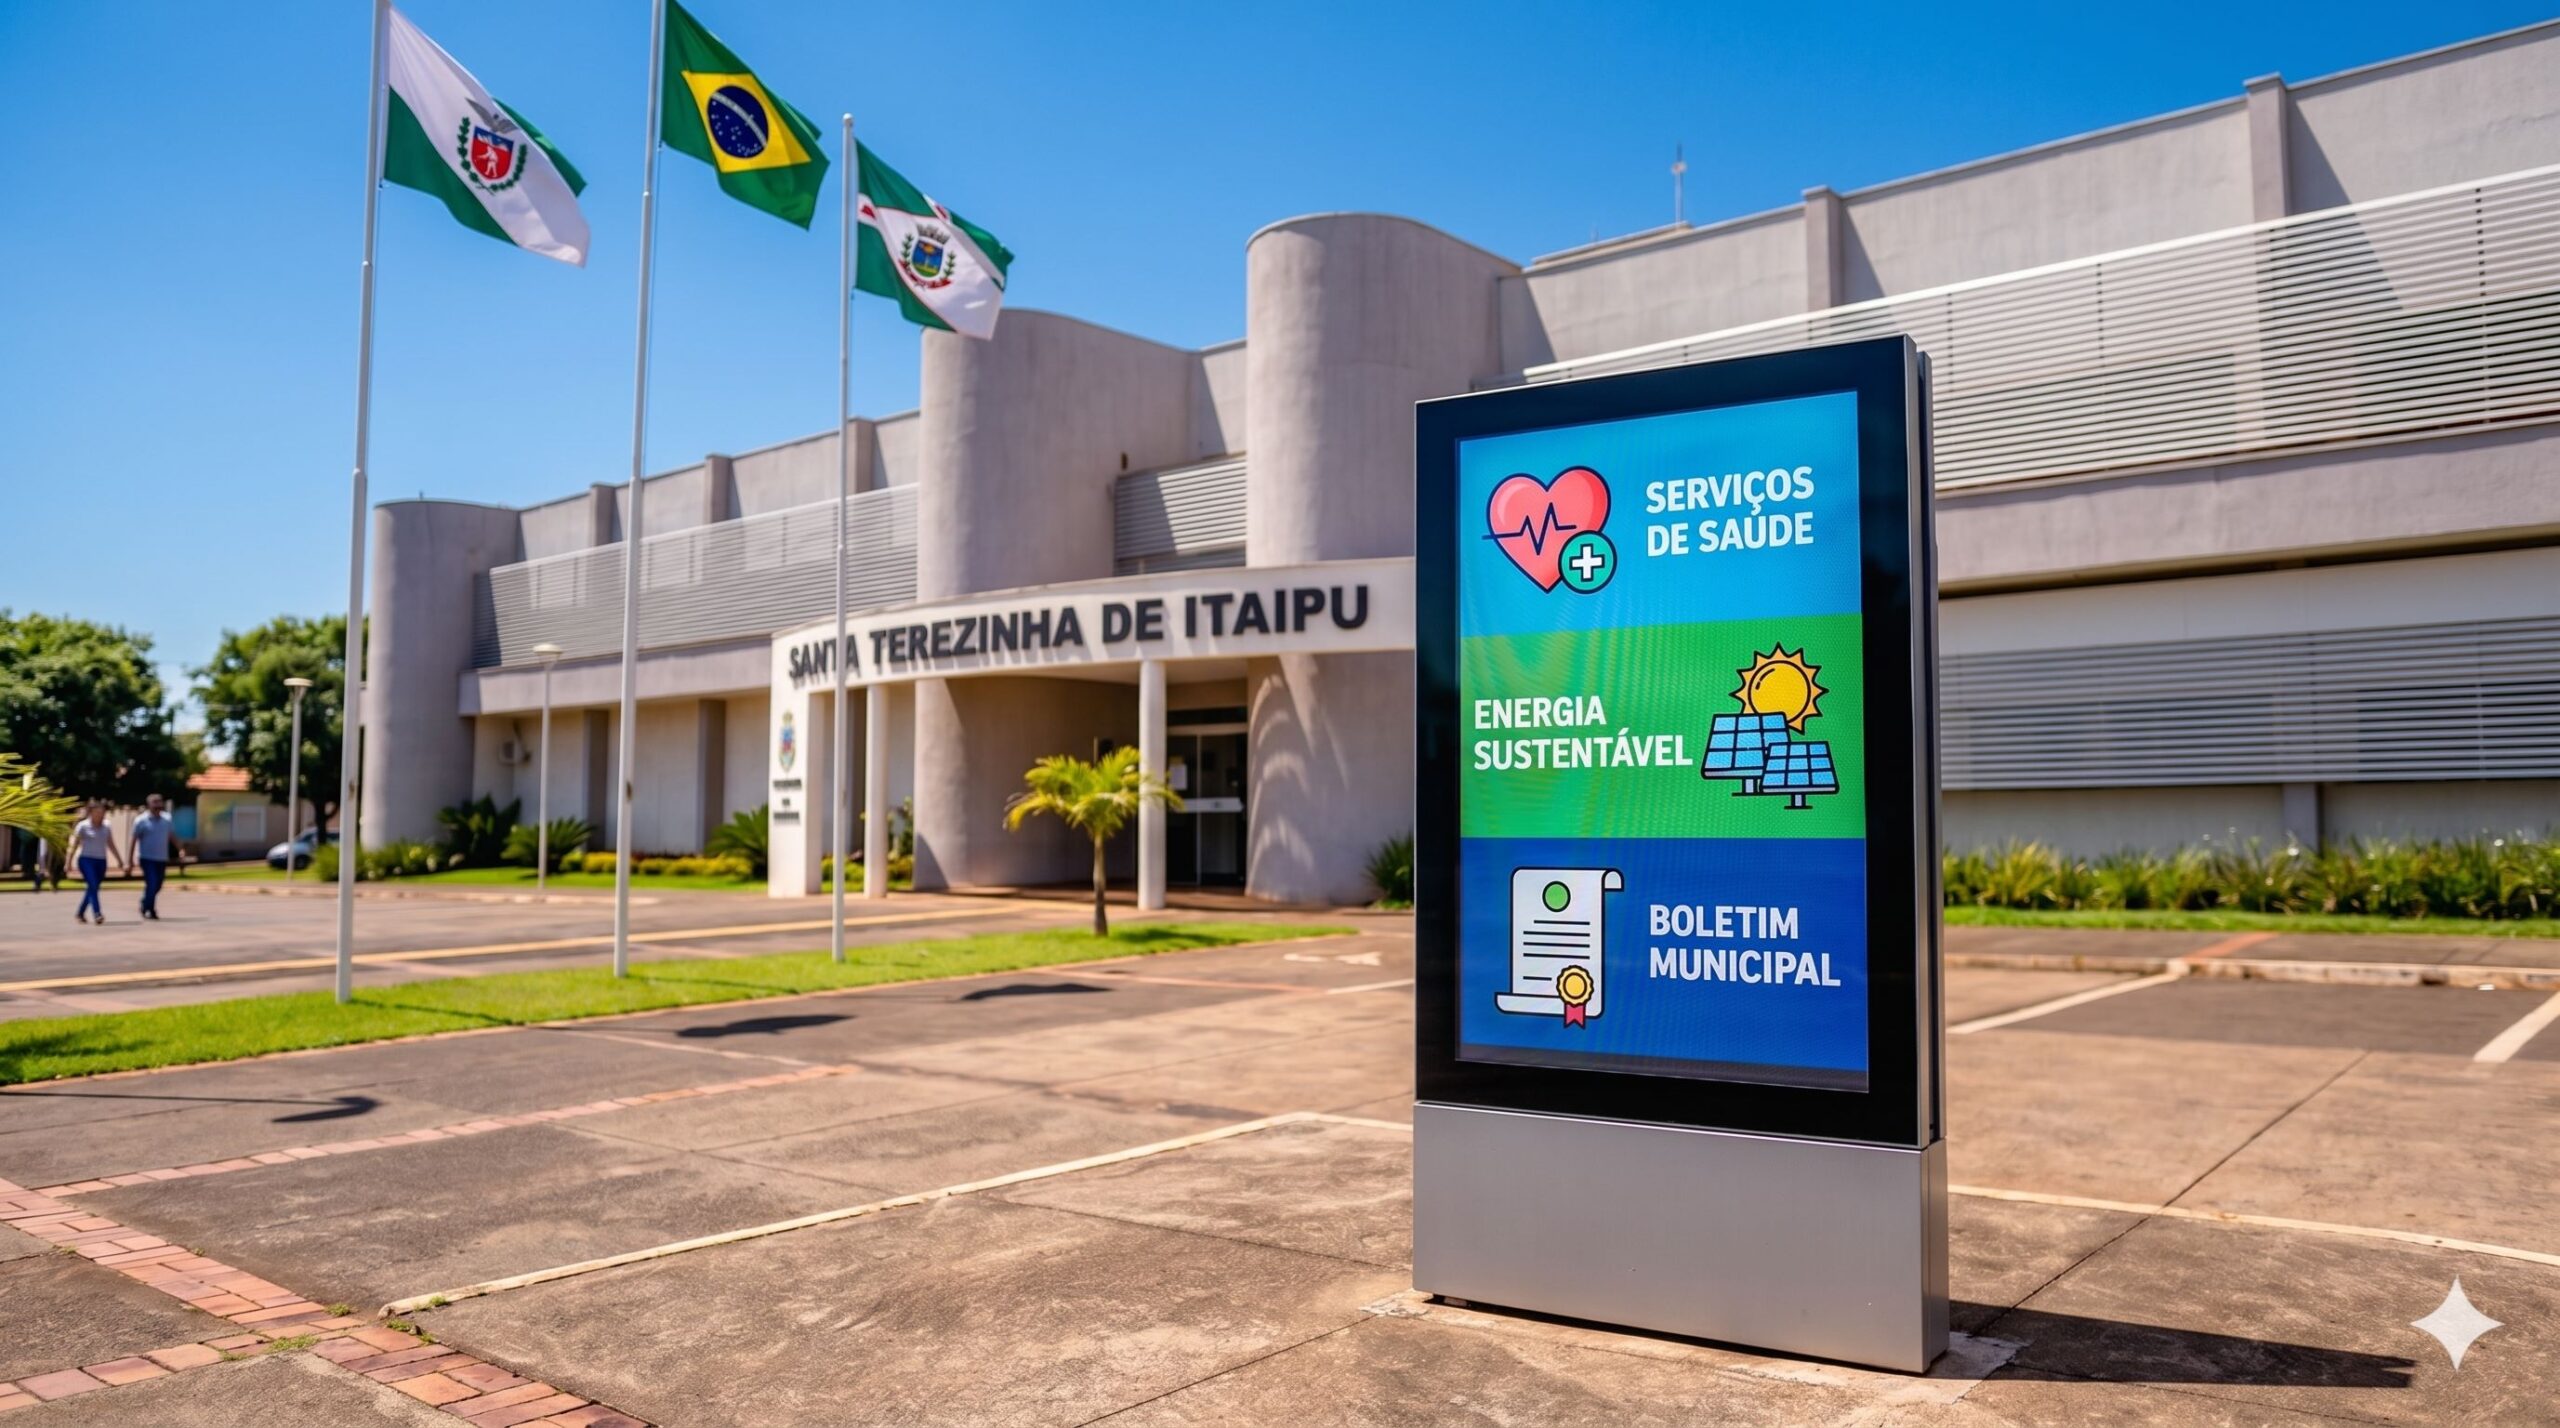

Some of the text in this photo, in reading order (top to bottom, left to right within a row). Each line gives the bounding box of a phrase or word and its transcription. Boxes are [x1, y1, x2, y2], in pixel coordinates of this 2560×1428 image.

[1646, 466, 1815, 517] SERVIÇOS
[1647, 523, 1690, 557] DE
[789, 584, 1370, 679] SANTA TEREZINHA DE ITAIPU
[1474, 695, 1607, 730] ENERGIA
[1473, 727, 1693, 771] SUSTENTÁVEL
[1649, 904, 1799, 940] BOLETIM
[1649, 947, 1841, 987] MUNICIPAL
